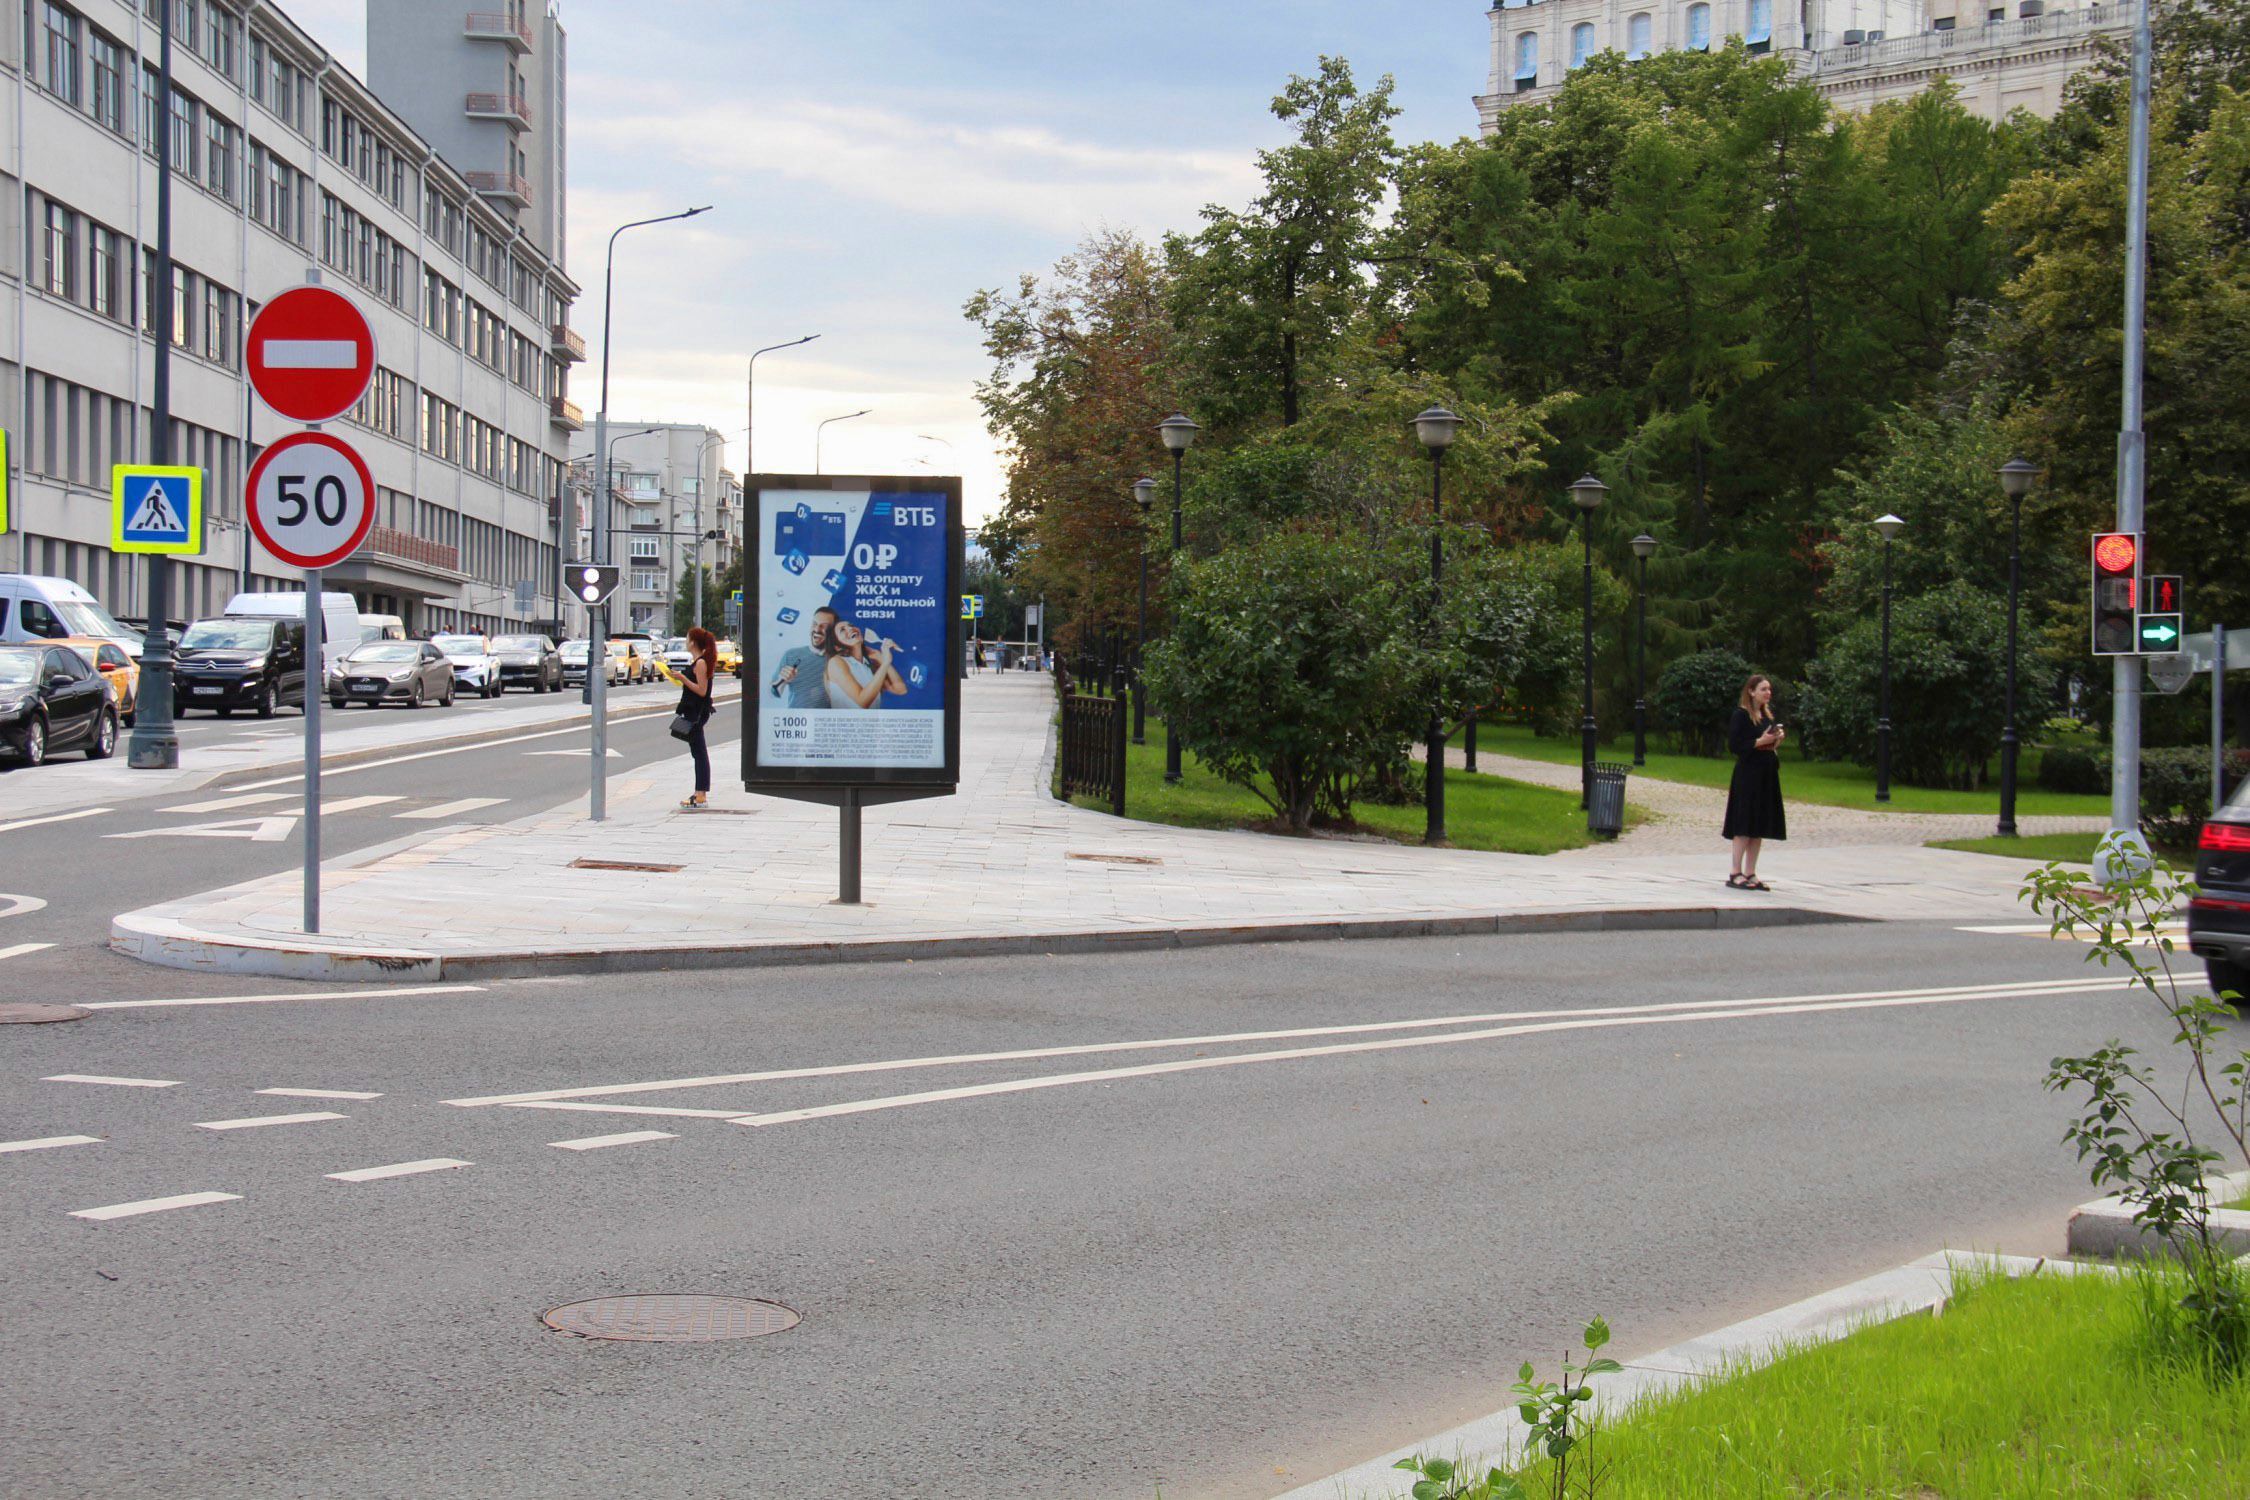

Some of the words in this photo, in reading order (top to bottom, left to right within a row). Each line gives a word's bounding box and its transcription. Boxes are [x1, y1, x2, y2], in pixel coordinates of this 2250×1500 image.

[277, 474, 348, 527] 50
[893, 507, 936, 526] ВТБ
[855, 575, 871, 583] за
[874, 575, 923, 586] оплату
[855, 584, 889, 595] ЖКХ
[891, 587, 901, 595] и
[855, 596, 936, 607] мобильной
[855, 610, 896, 619] связи
[782, 717, 807, 727] 1000
[774, 730, 807, 739] VTB.RU
